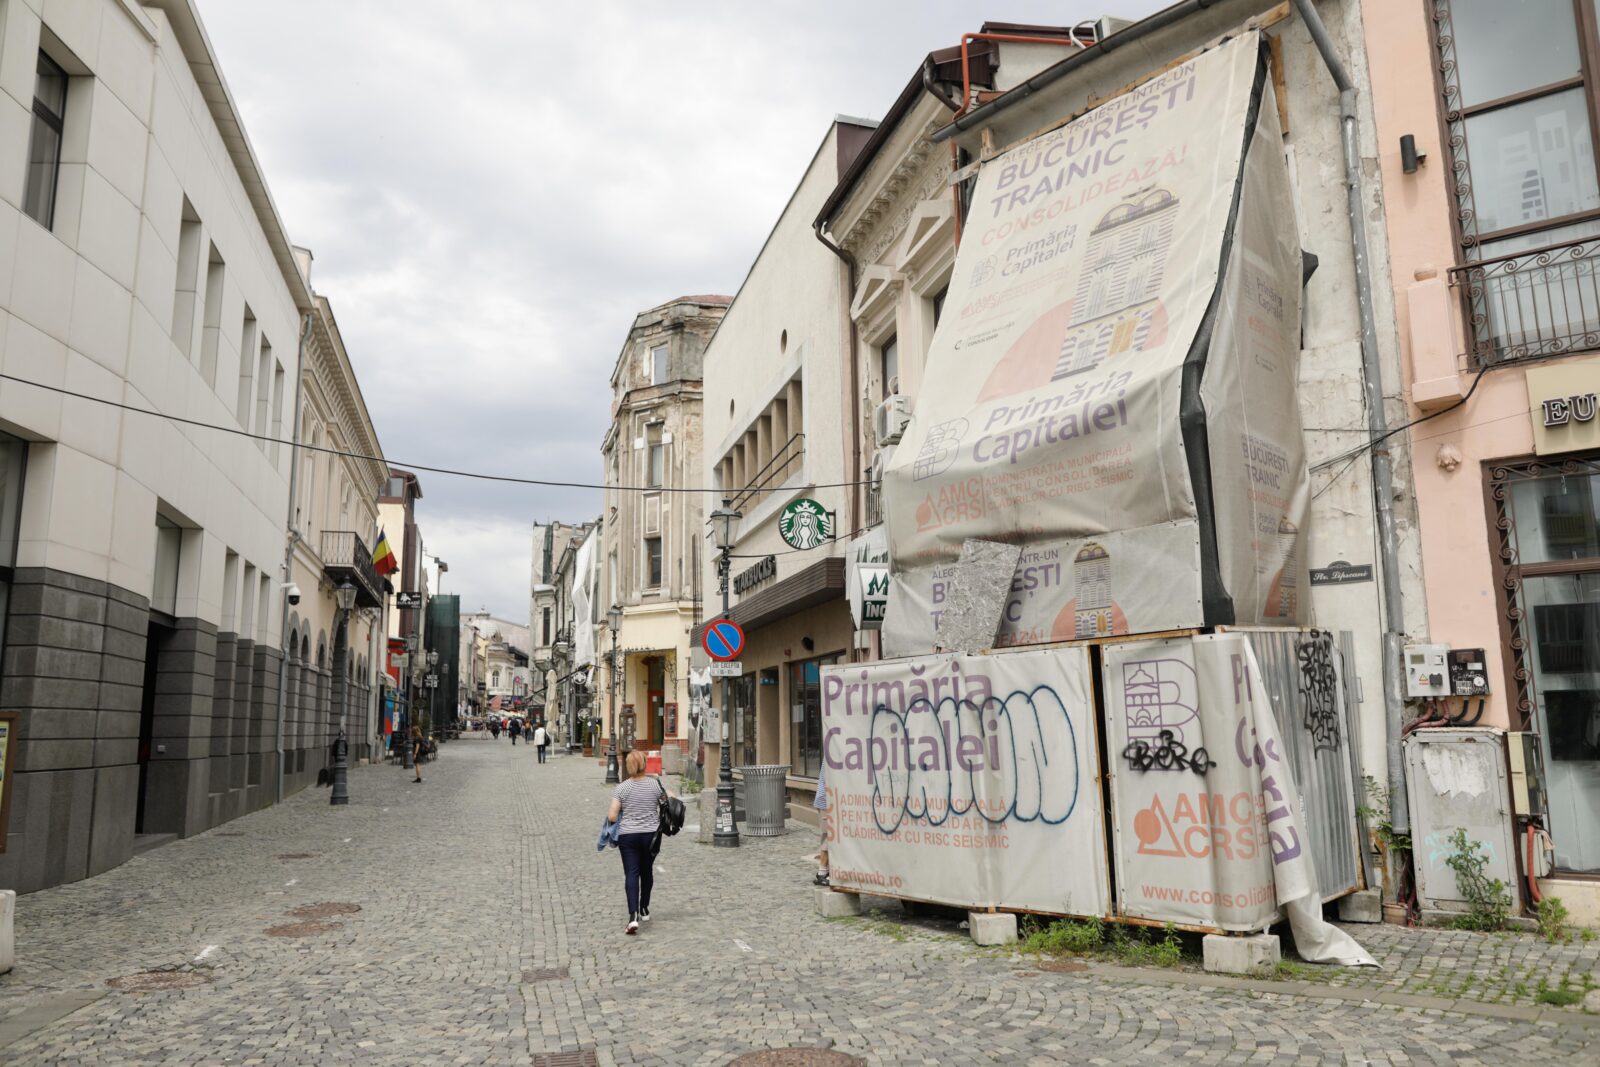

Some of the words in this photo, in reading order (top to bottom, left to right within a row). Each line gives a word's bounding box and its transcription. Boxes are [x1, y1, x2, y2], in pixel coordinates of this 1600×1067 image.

[996, 76, 1196, 190] BUCUREȘTI
[981, 144, 1188, 246] CONSOLIDEAZĂ!
[990, 139, 1128, 218] TRAINIC
[1001, 235, 1075, 276] Capitalei
[1006, 224, 1077, 262] Primăria
[983, 370, 1133, 431] Primăria
[973, 389, 1129, 464] Capitalei
[938, 478, 980, 505] AMC
[1036, 457, 1132, 489] CONSOLIDAREA
[1048, 487, 1064, 500] CU
[1066, 480, 1092, 496] RISC
[1094, 468, 1135, 489] SEISMIC
[1244, 463, 1281, 490] TRAINIC
[942, 502, 982, 526] CRS
[734, 555, 776, 595] STARBUCKS
[824, 661, 993, 717] Primăria
[824, 719, 1001, 785] Capitalei
[841, 810, 886, 825] PENTRU
[891, 812, 1008, 831] CONSOLIDAREA
[1173, 792, 1252, 827] AMC
[904, 830, 921, 844] CU
[924, 832, 950, 847] RISC
[952, 833, 1010, 849] SEISMIC
[1184, 826, 1256, 860] CRS
